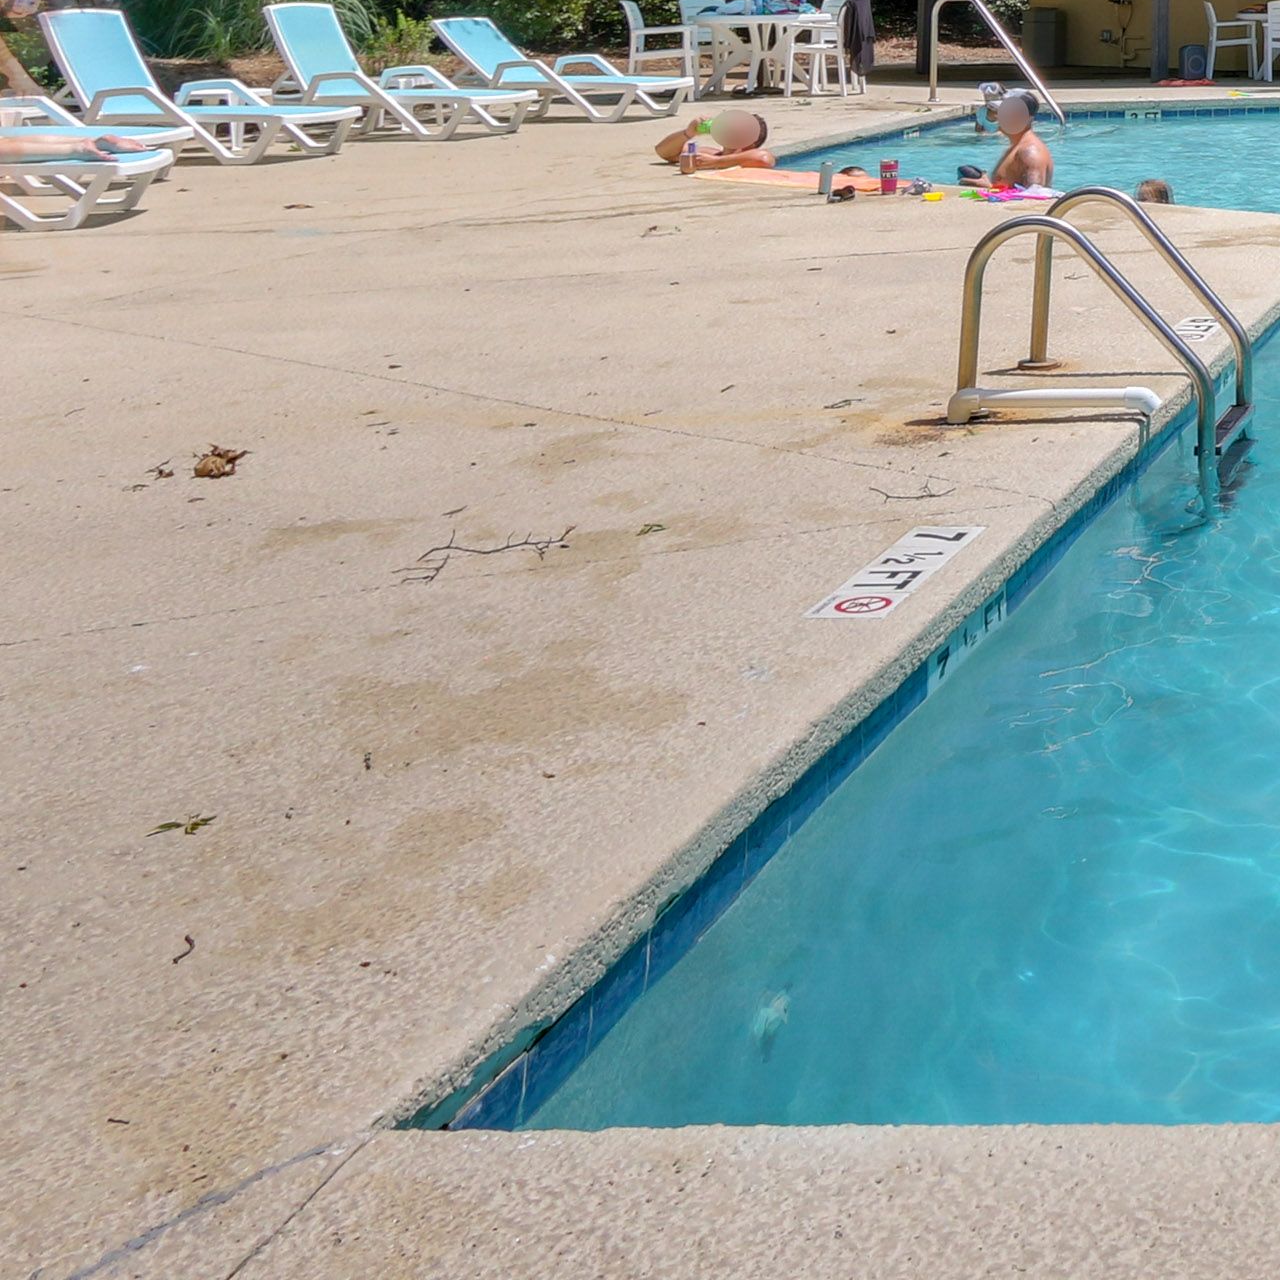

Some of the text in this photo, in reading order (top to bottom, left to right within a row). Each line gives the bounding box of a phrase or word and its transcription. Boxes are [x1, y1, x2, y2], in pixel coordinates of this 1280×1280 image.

[914, 532, 969, 542] 7
[853, 570, 925, 590] FT
[936, 645, 950, 680] 7
[984, 591, 1005, 633] FT
